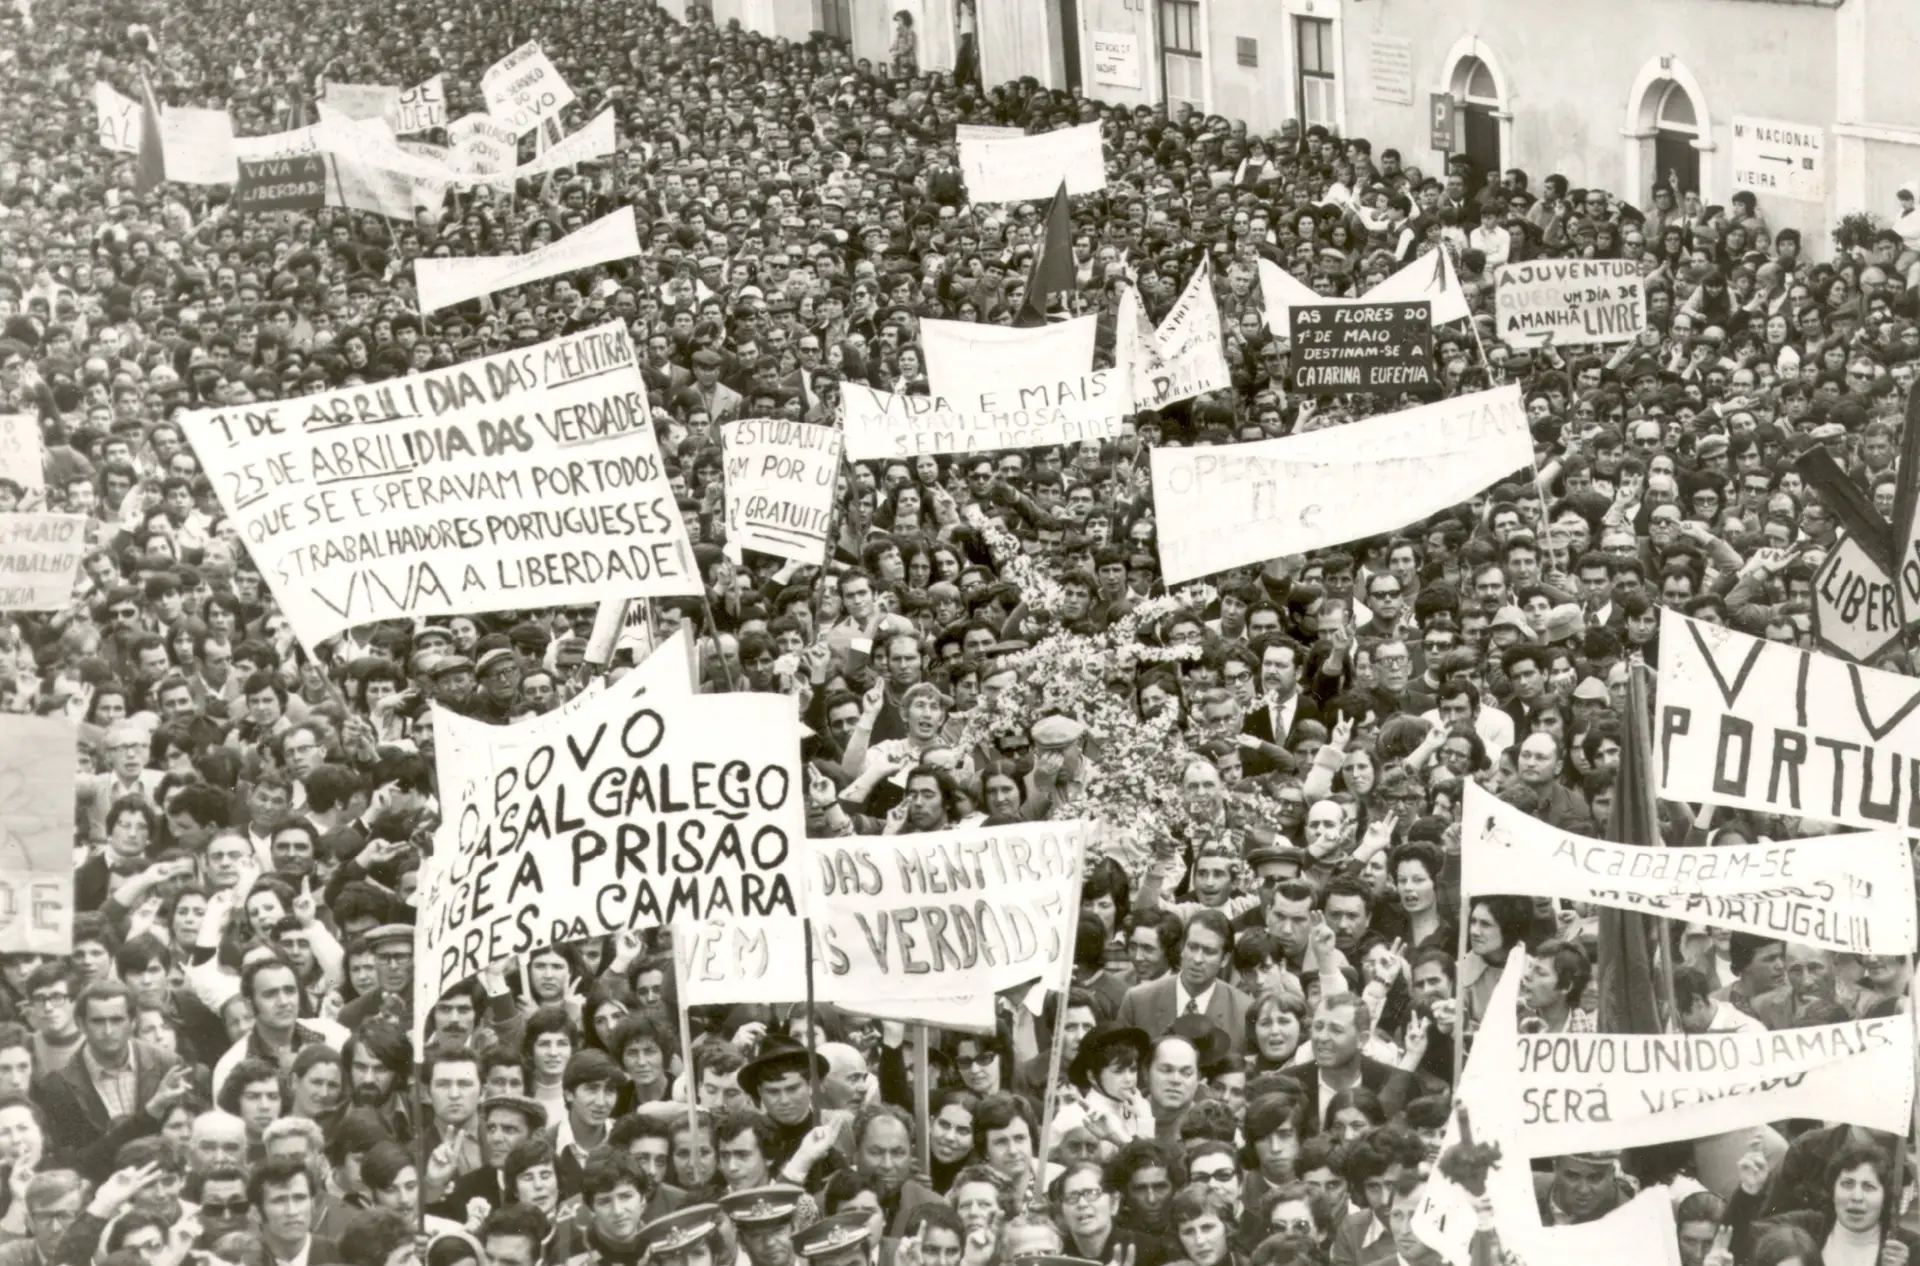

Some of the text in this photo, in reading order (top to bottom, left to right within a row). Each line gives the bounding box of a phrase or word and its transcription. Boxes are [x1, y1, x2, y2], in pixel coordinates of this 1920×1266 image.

[1435, 102, 1446, 129] P
[1756, 126, 1820, 149] NACIONAL
[244, 158, 318, 178] VIVA A
[1735, 169, 1777, 189] VIEIRA
[1518, 261, 1644, 285] JUVENTUDE
[1563, 290, 1582, 304] UM
[1617, 283, 1638, 299] DE
[1297, 307, 1428, 325] AS FLORES DO
[1508, 301, 1642, 335] AMANHÃ LIVRE
[1314, 329, 1333, 343] DE
[1343, 328, 1391, 343] MAIO
[1303, 344, 1424, 361] DESTINAM-SE A
[244, 408, 287, 437] DE
[424, 371, 487, 416] DIA
[484, 353, 537, 402] DAS
[544, 328, 634, 384] MENTIRAS
[1296, 365, 1361, 388] CATARINA
[868, 372, 1107, 418] VIDA E MAIS
[1062, 415, 1118, 441] PIDE
[223, 463, 264, 504] 25
[266, 451, 304, 487] DE
[414, 427, 477, 465] DIA
[477, 414, 534, 457] DAS
[535, 391, 646, 442] VERDADES
[761, 454, 805, 483] POR
[248, 453, 659, 543] QUE SE ESPERAVAM POR TODOS
[12, 522, 76, 545] MAIO
[289, 517, 484, 578] TRABALHADORES
[485, 497, 673, 546] PORTUGUESES
[311, 538, 693, 619] VIVA A LIBERDADE!
[588, 758, 790, 820] GALEGO
[505, 850, 544, 904] A
[571, 807, 790, 888] PRISÃO
[816, 846, 883, 896] DAS
[438, 871, 798, 998] PRES. DA CAMARA
[1532, 1037, 1615, 1073] POVO
[1623, 1037, 1740, 1073] UNIDO
[1748, 1020, 1893, 1068] JAMAIS
